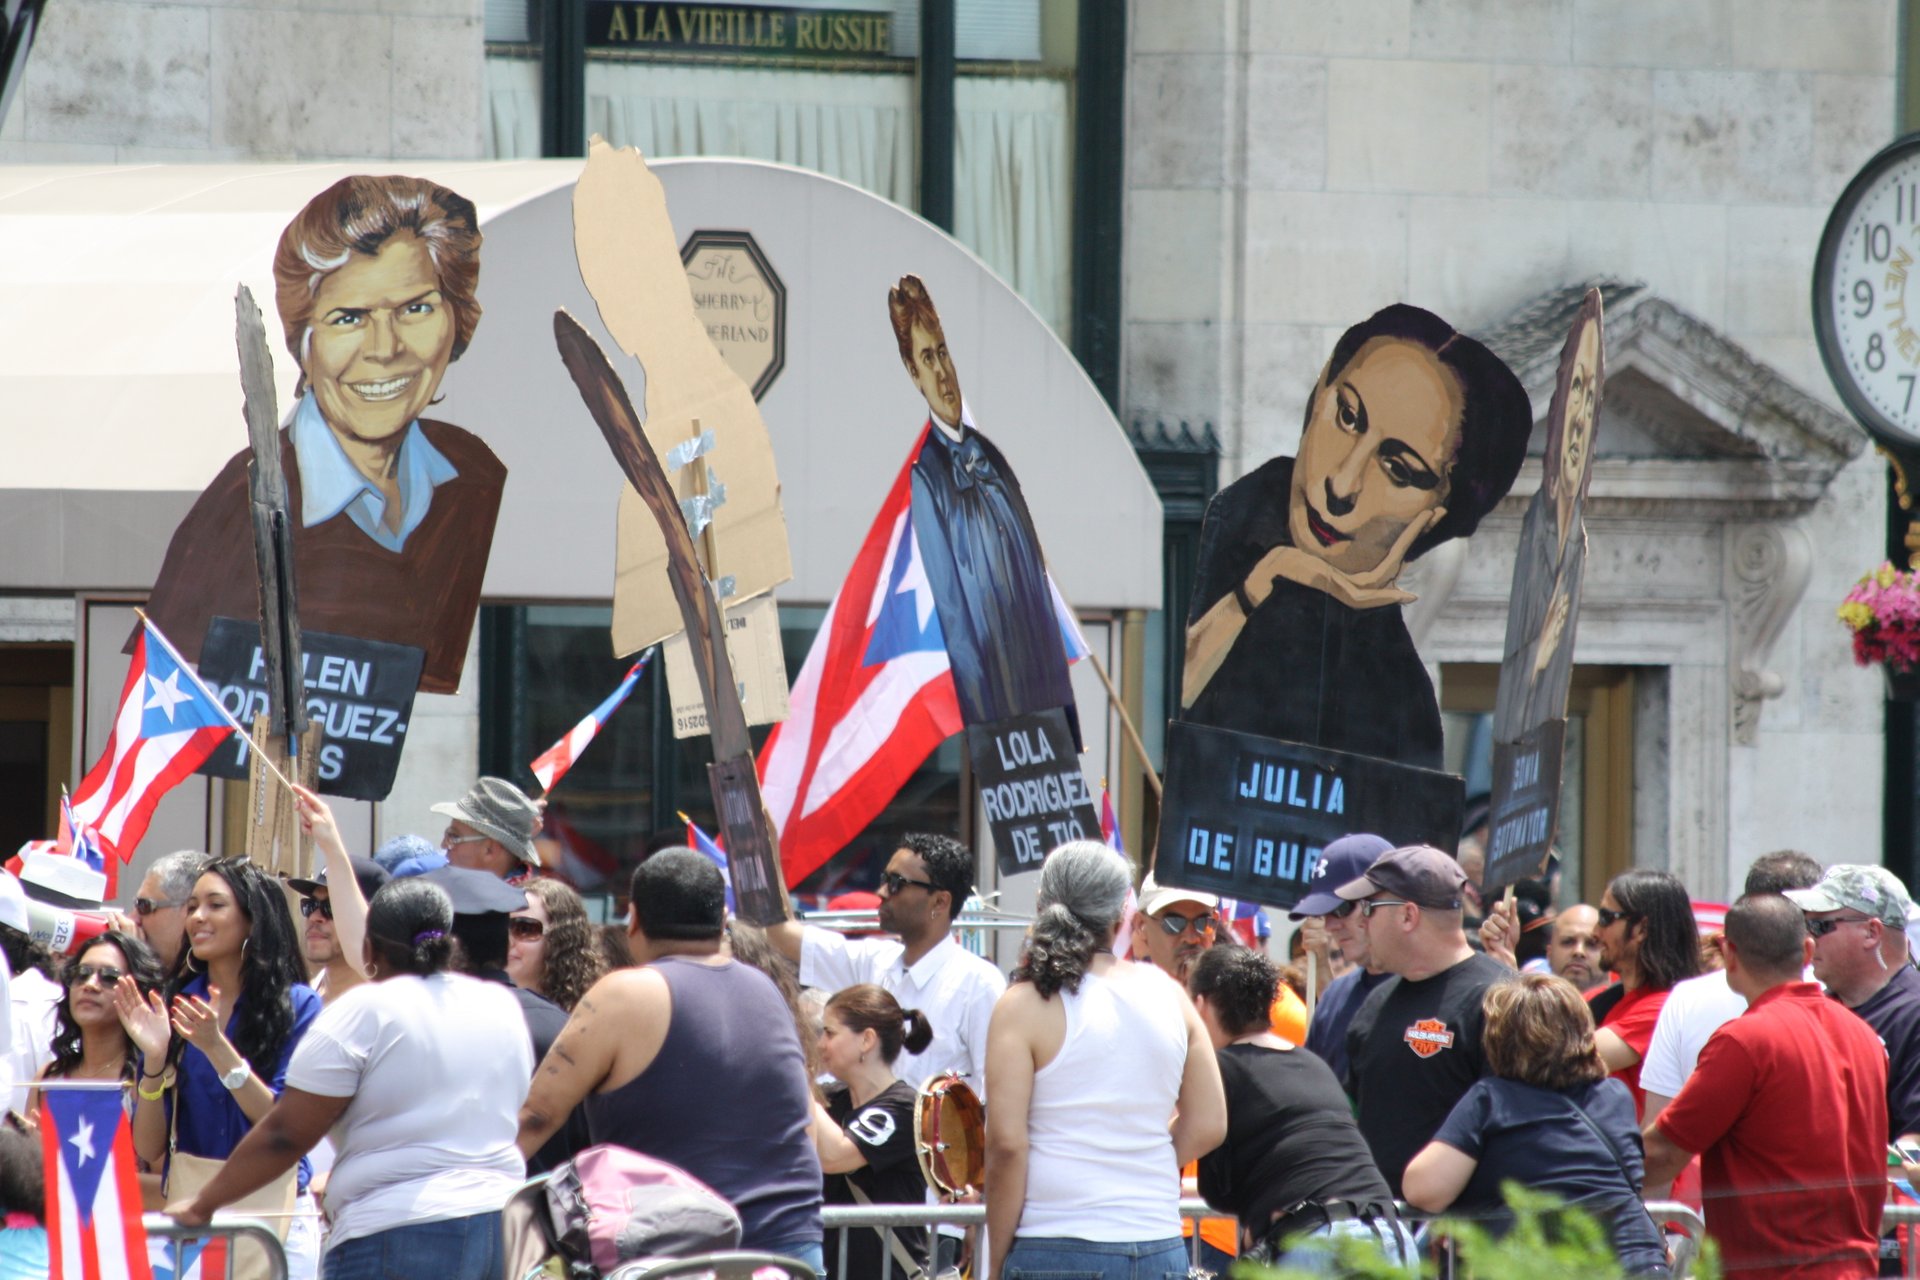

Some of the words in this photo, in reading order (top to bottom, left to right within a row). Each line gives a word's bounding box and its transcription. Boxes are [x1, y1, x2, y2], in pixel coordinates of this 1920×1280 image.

[608, 5, 629, 41] A
[635, 7, 671, 43] LA
[677, 9, 786, 47] VIEILLE
[795, 14, 890, 51] RUSSIE
[1896, 184, 1917, 225] 11
[1864, 223, 1891, 264] 10
[1853, 279, 1874, 319] 9
[1864, 332, 1886, 372] 8
[1897, 374, 1917, 414] 7
[248, 646, 371, 697] HLEN
[995, 727, 1056, 771] LOLA
[981, 770, 1093, 822] RODRIGUEZ
[1240, 761, 1345, 815] JULIA
[1011, 826, 1044, 864] DE
[1188, 827, 1234, 872] DE
[1253, 838, 1323, 884] BUR
